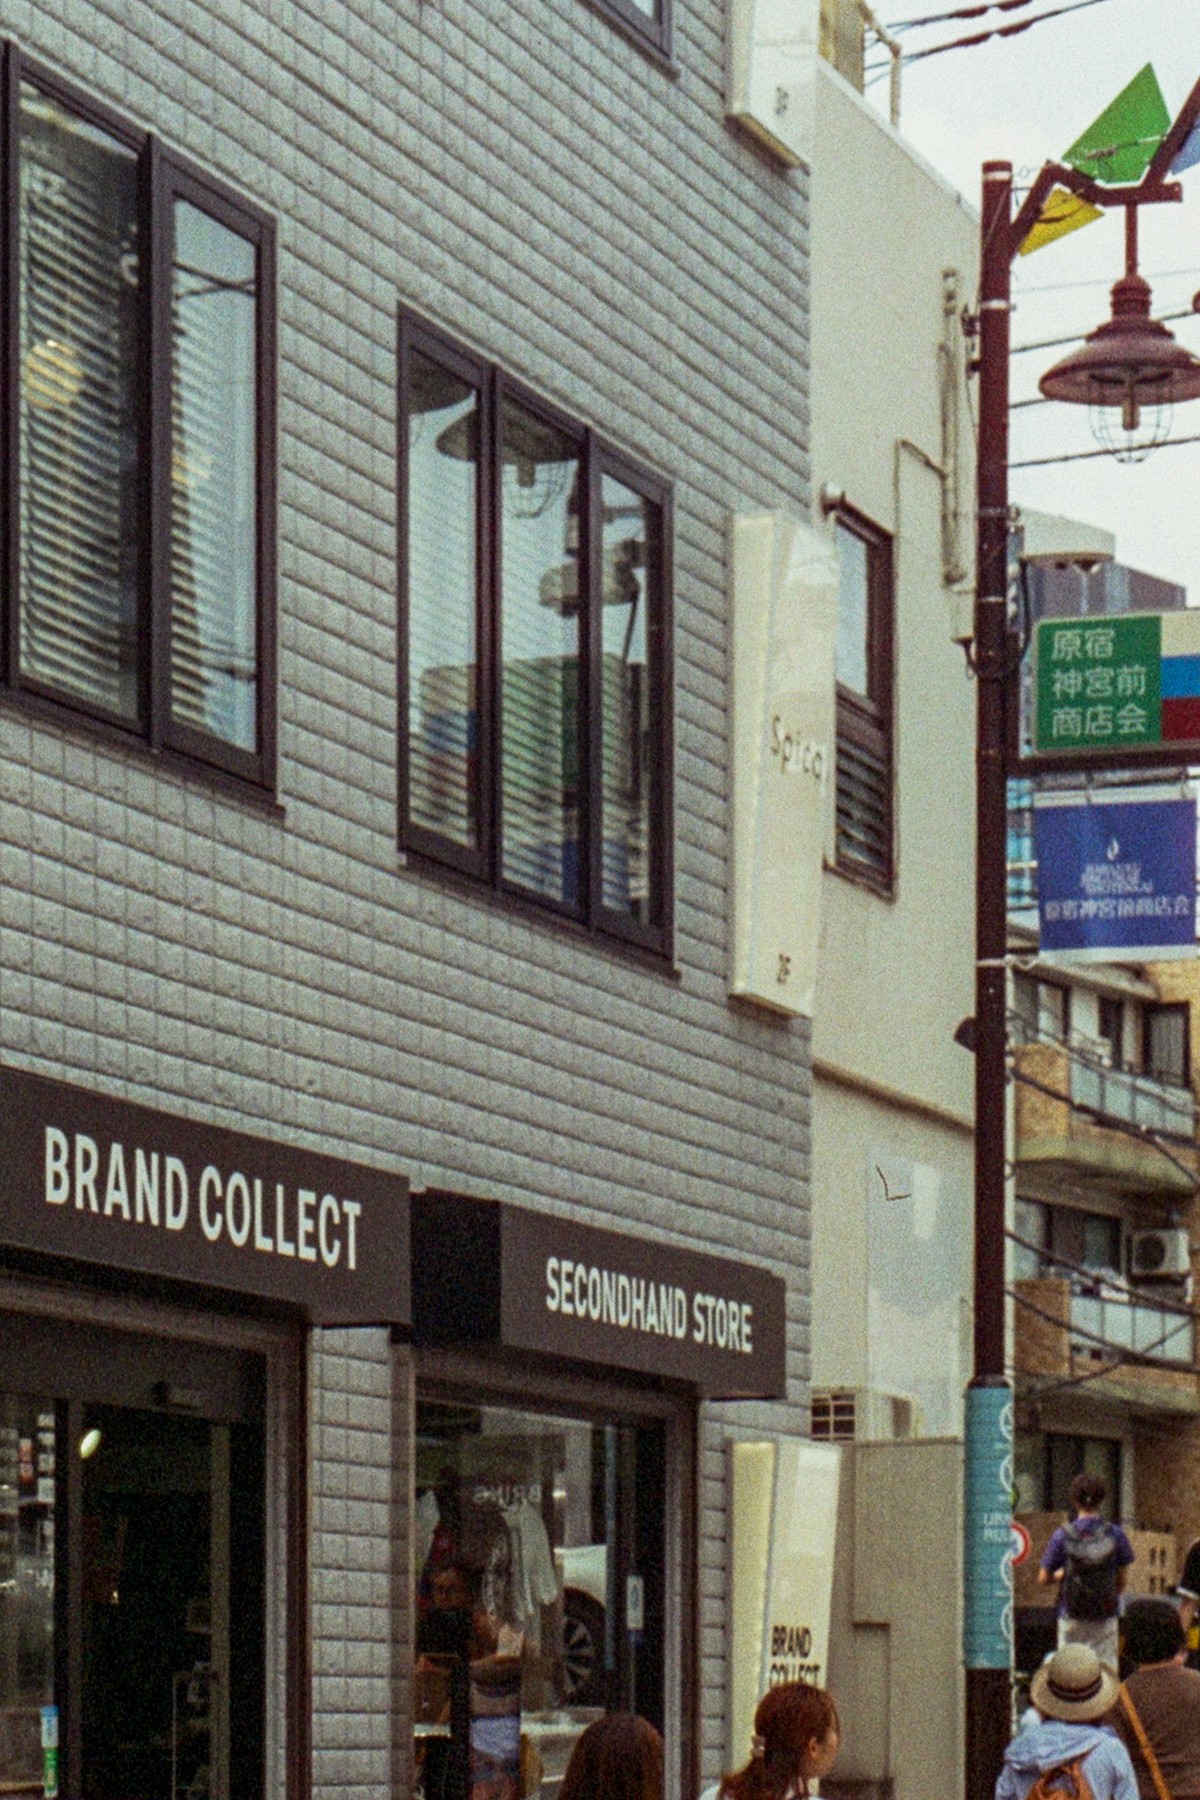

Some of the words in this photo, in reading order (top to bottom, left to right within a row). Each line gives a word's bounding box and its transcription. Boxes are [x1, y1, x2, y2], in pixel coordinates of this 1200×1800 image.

[1052, 629, 1115, 661] 原宿
[1051, 665, 1147, 699] 神宮前
[1051, 704, 1148, 739] 商店会
[44, 1125, 188, 1231] BRAND
[199, 1165, 362, 1270] COLLECT
[546, 1257, 687, 1339] SECONDHAND
[693, 1292, 753, 1354] STORE
[772, 1625, 812, 1659] BRAND
